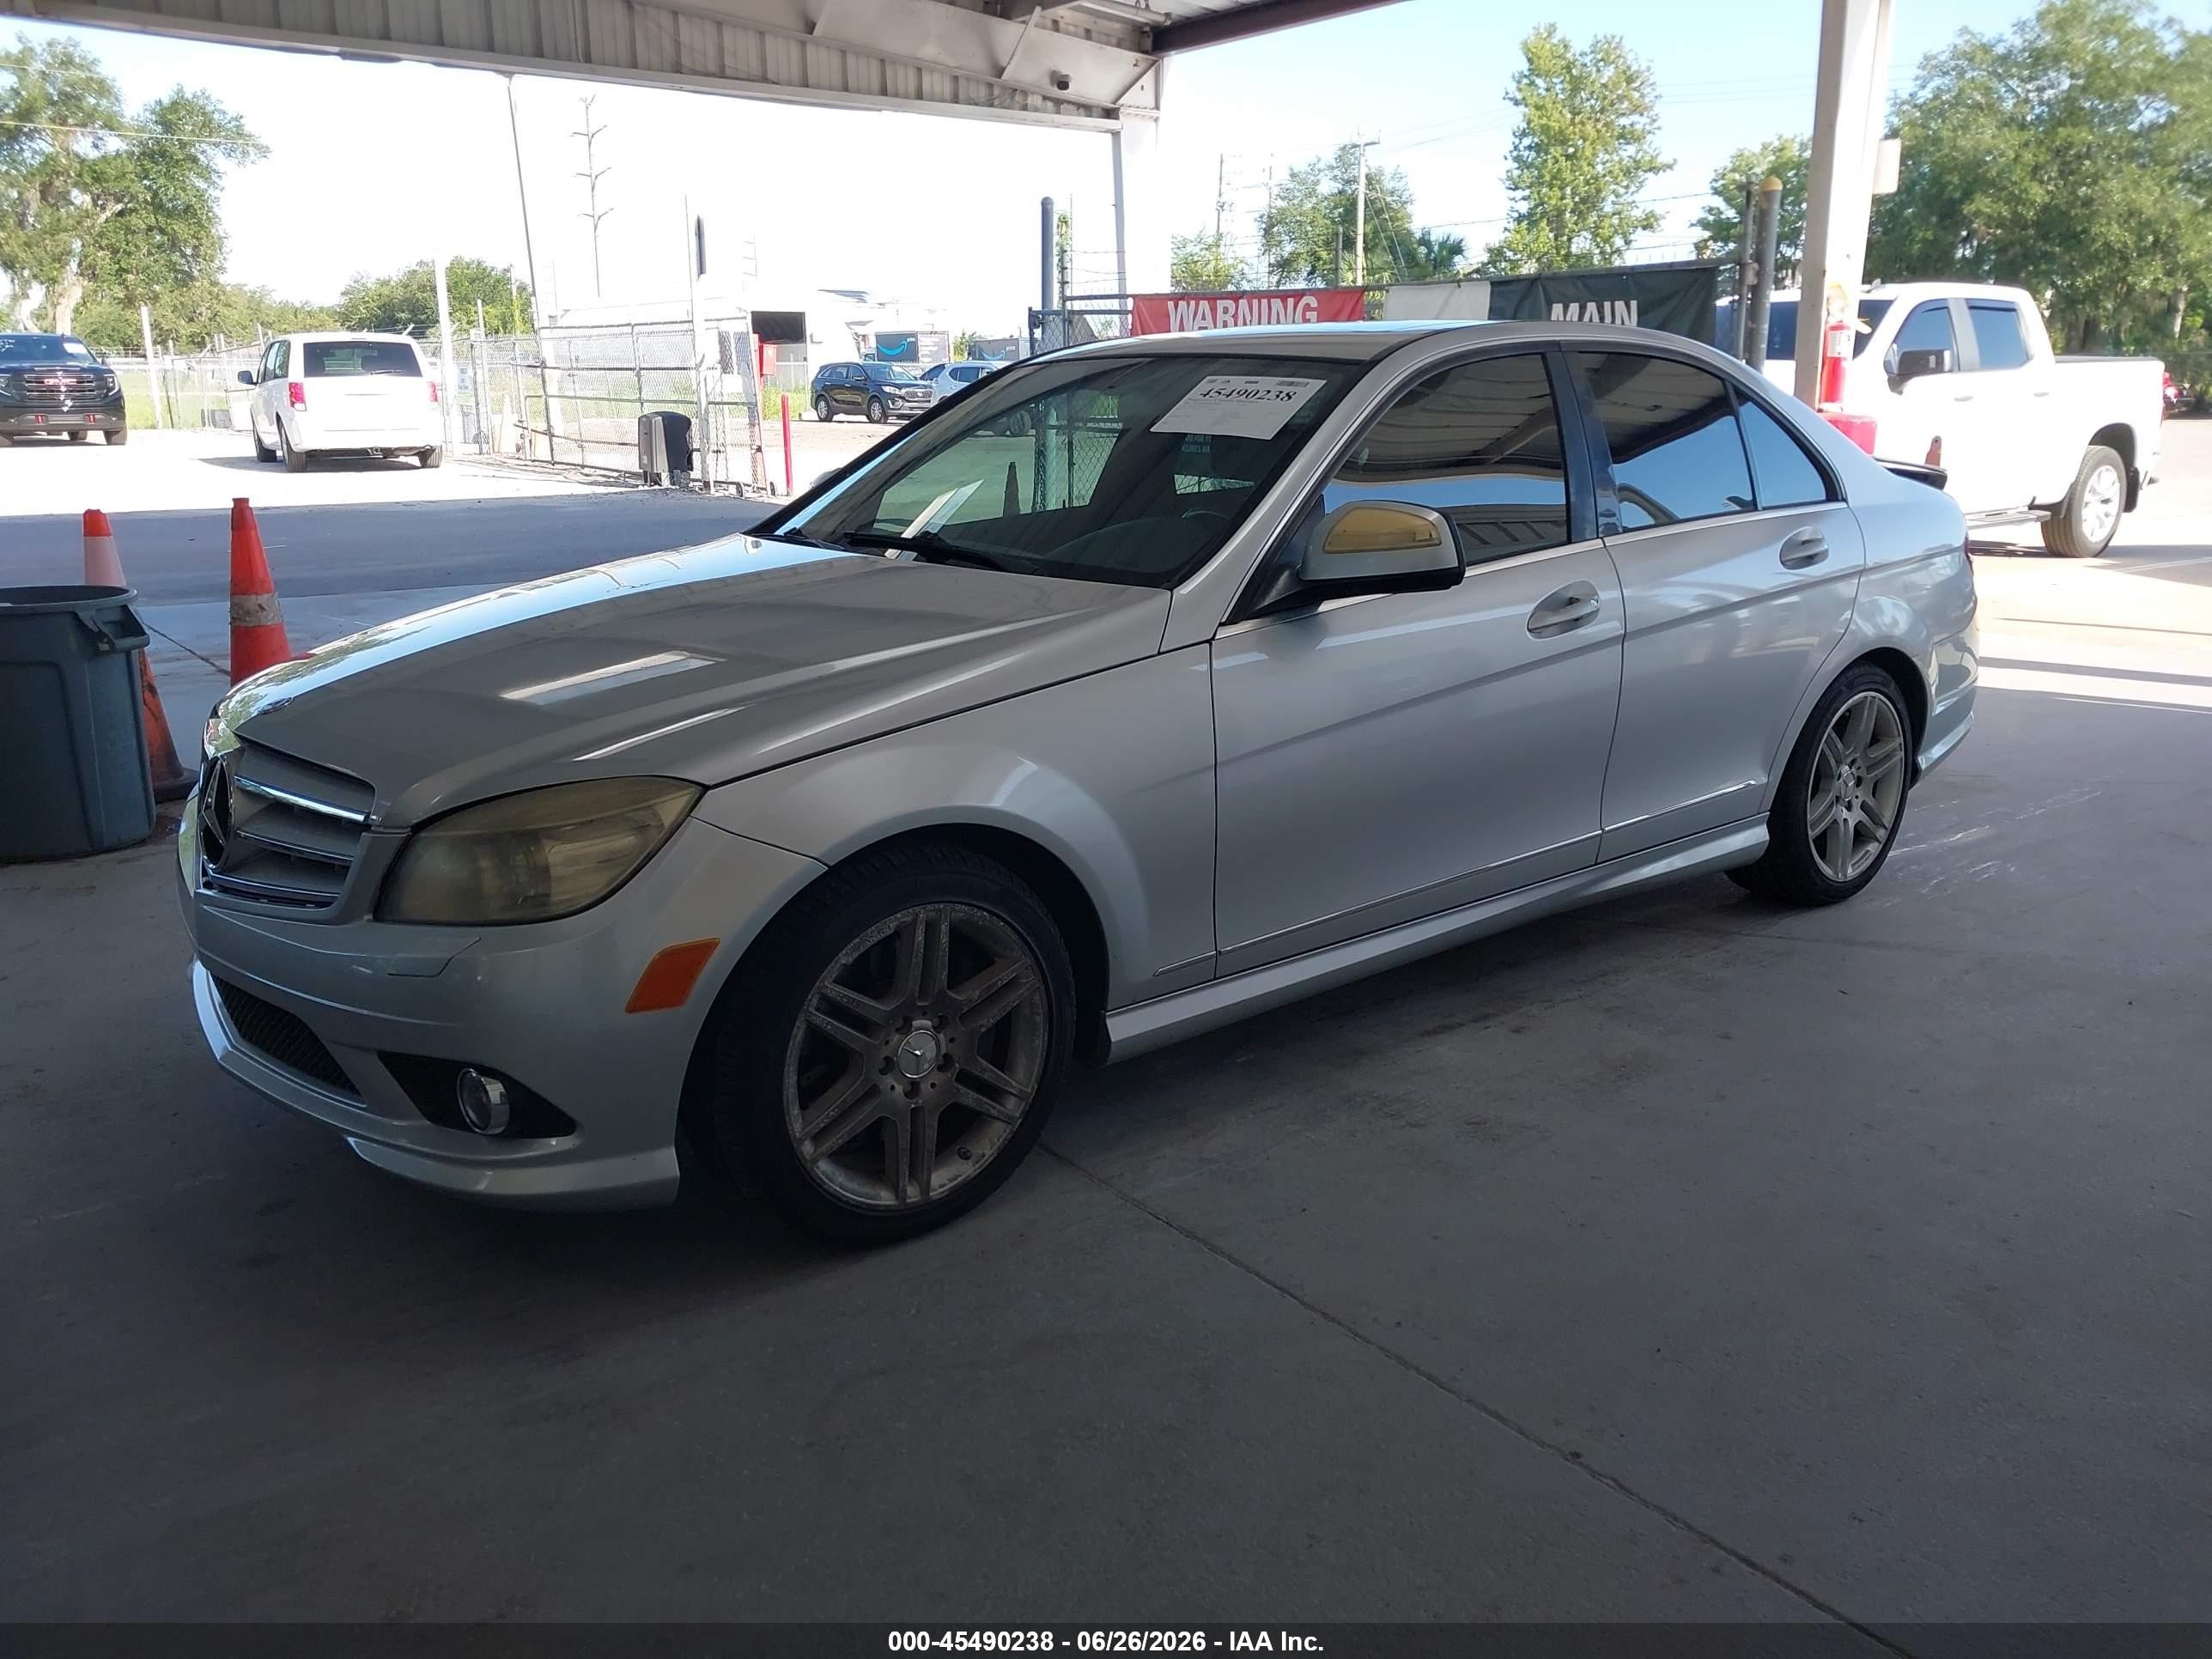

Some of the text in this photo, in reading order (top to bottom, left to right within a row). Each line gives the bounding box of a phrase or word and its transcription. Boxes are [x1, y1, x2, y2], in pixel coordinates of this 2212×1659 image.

[1167, 295, 1319, 333] WARNING
[1550, 299, 1638, 327] MAIN
[1199, 387, 1297, 403] 45490238
